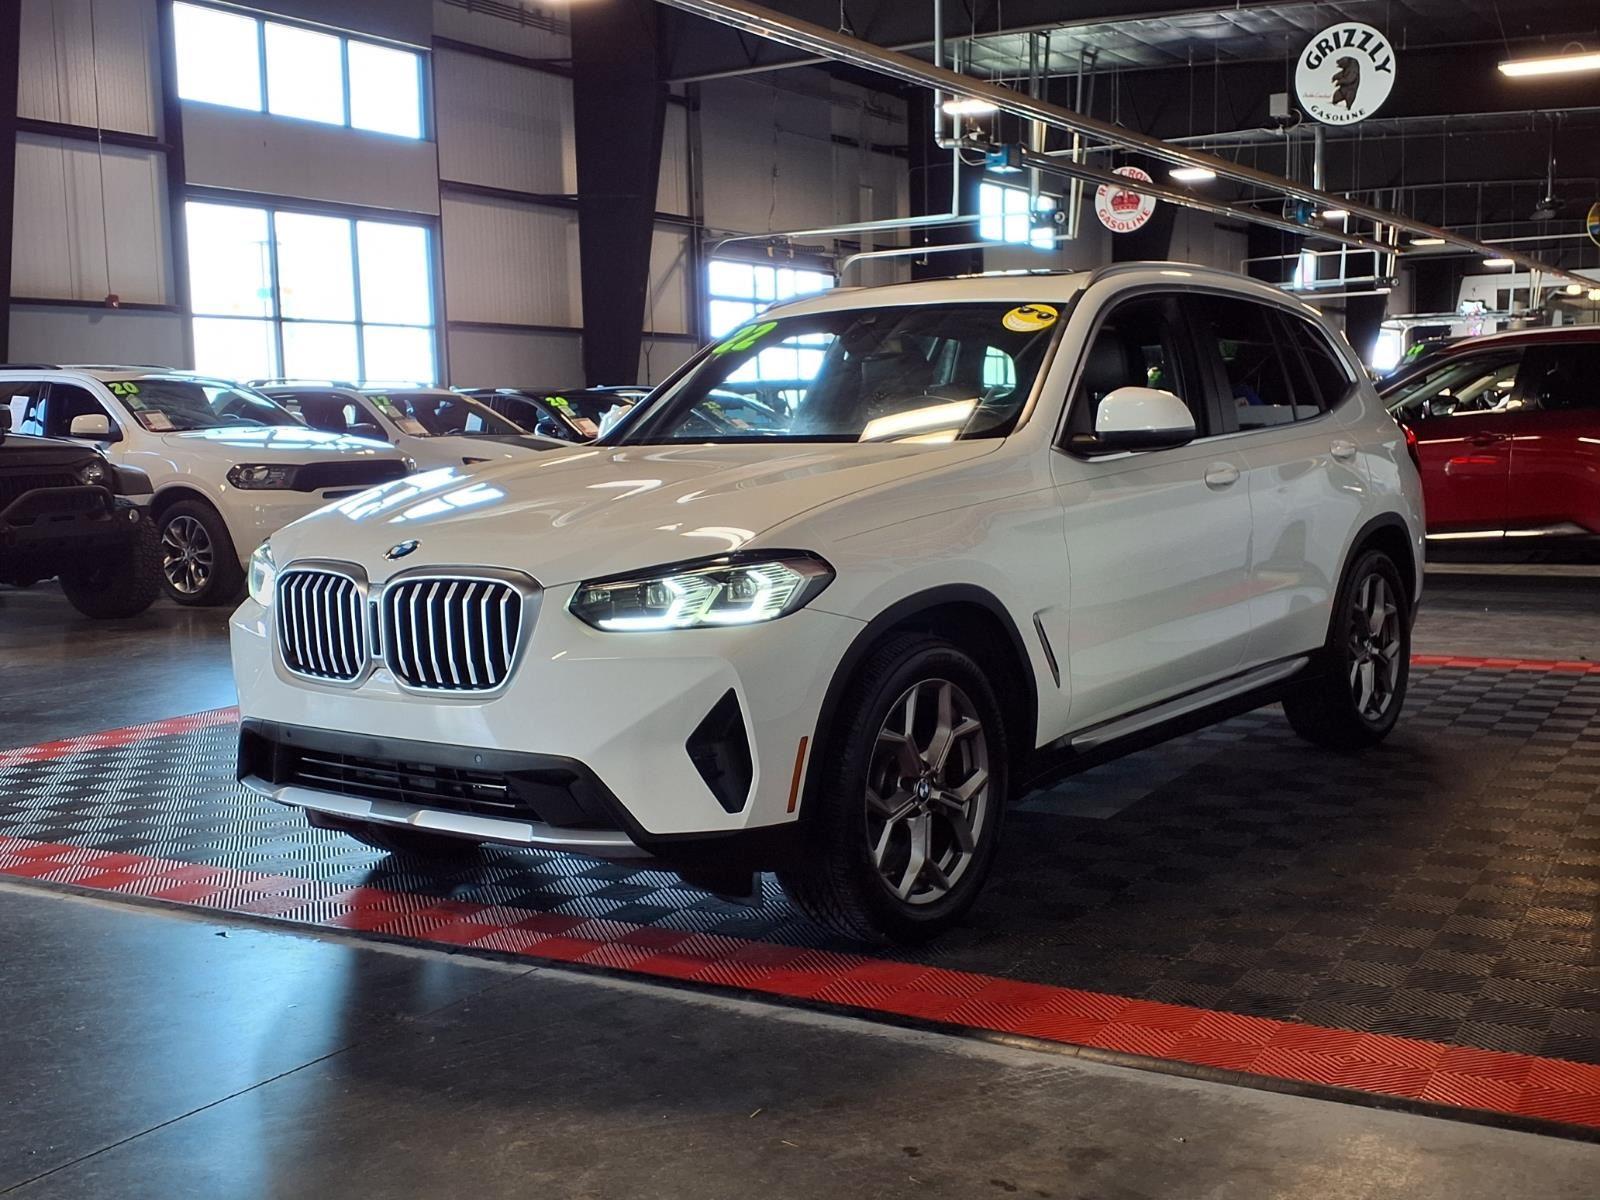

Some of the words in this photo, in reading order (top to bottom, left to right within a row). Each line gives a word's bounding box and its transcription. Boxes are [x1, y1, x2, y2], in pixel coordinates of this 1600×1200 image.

[1305, 28, 1391, 74] GRIZZLY
[1311, 105, 1365, 121] GASOLINE
[1099, 208, 1150, 230] GASOLINE
[711, 321, 778, 355] 22
[108, 382, 140, 395] 20
